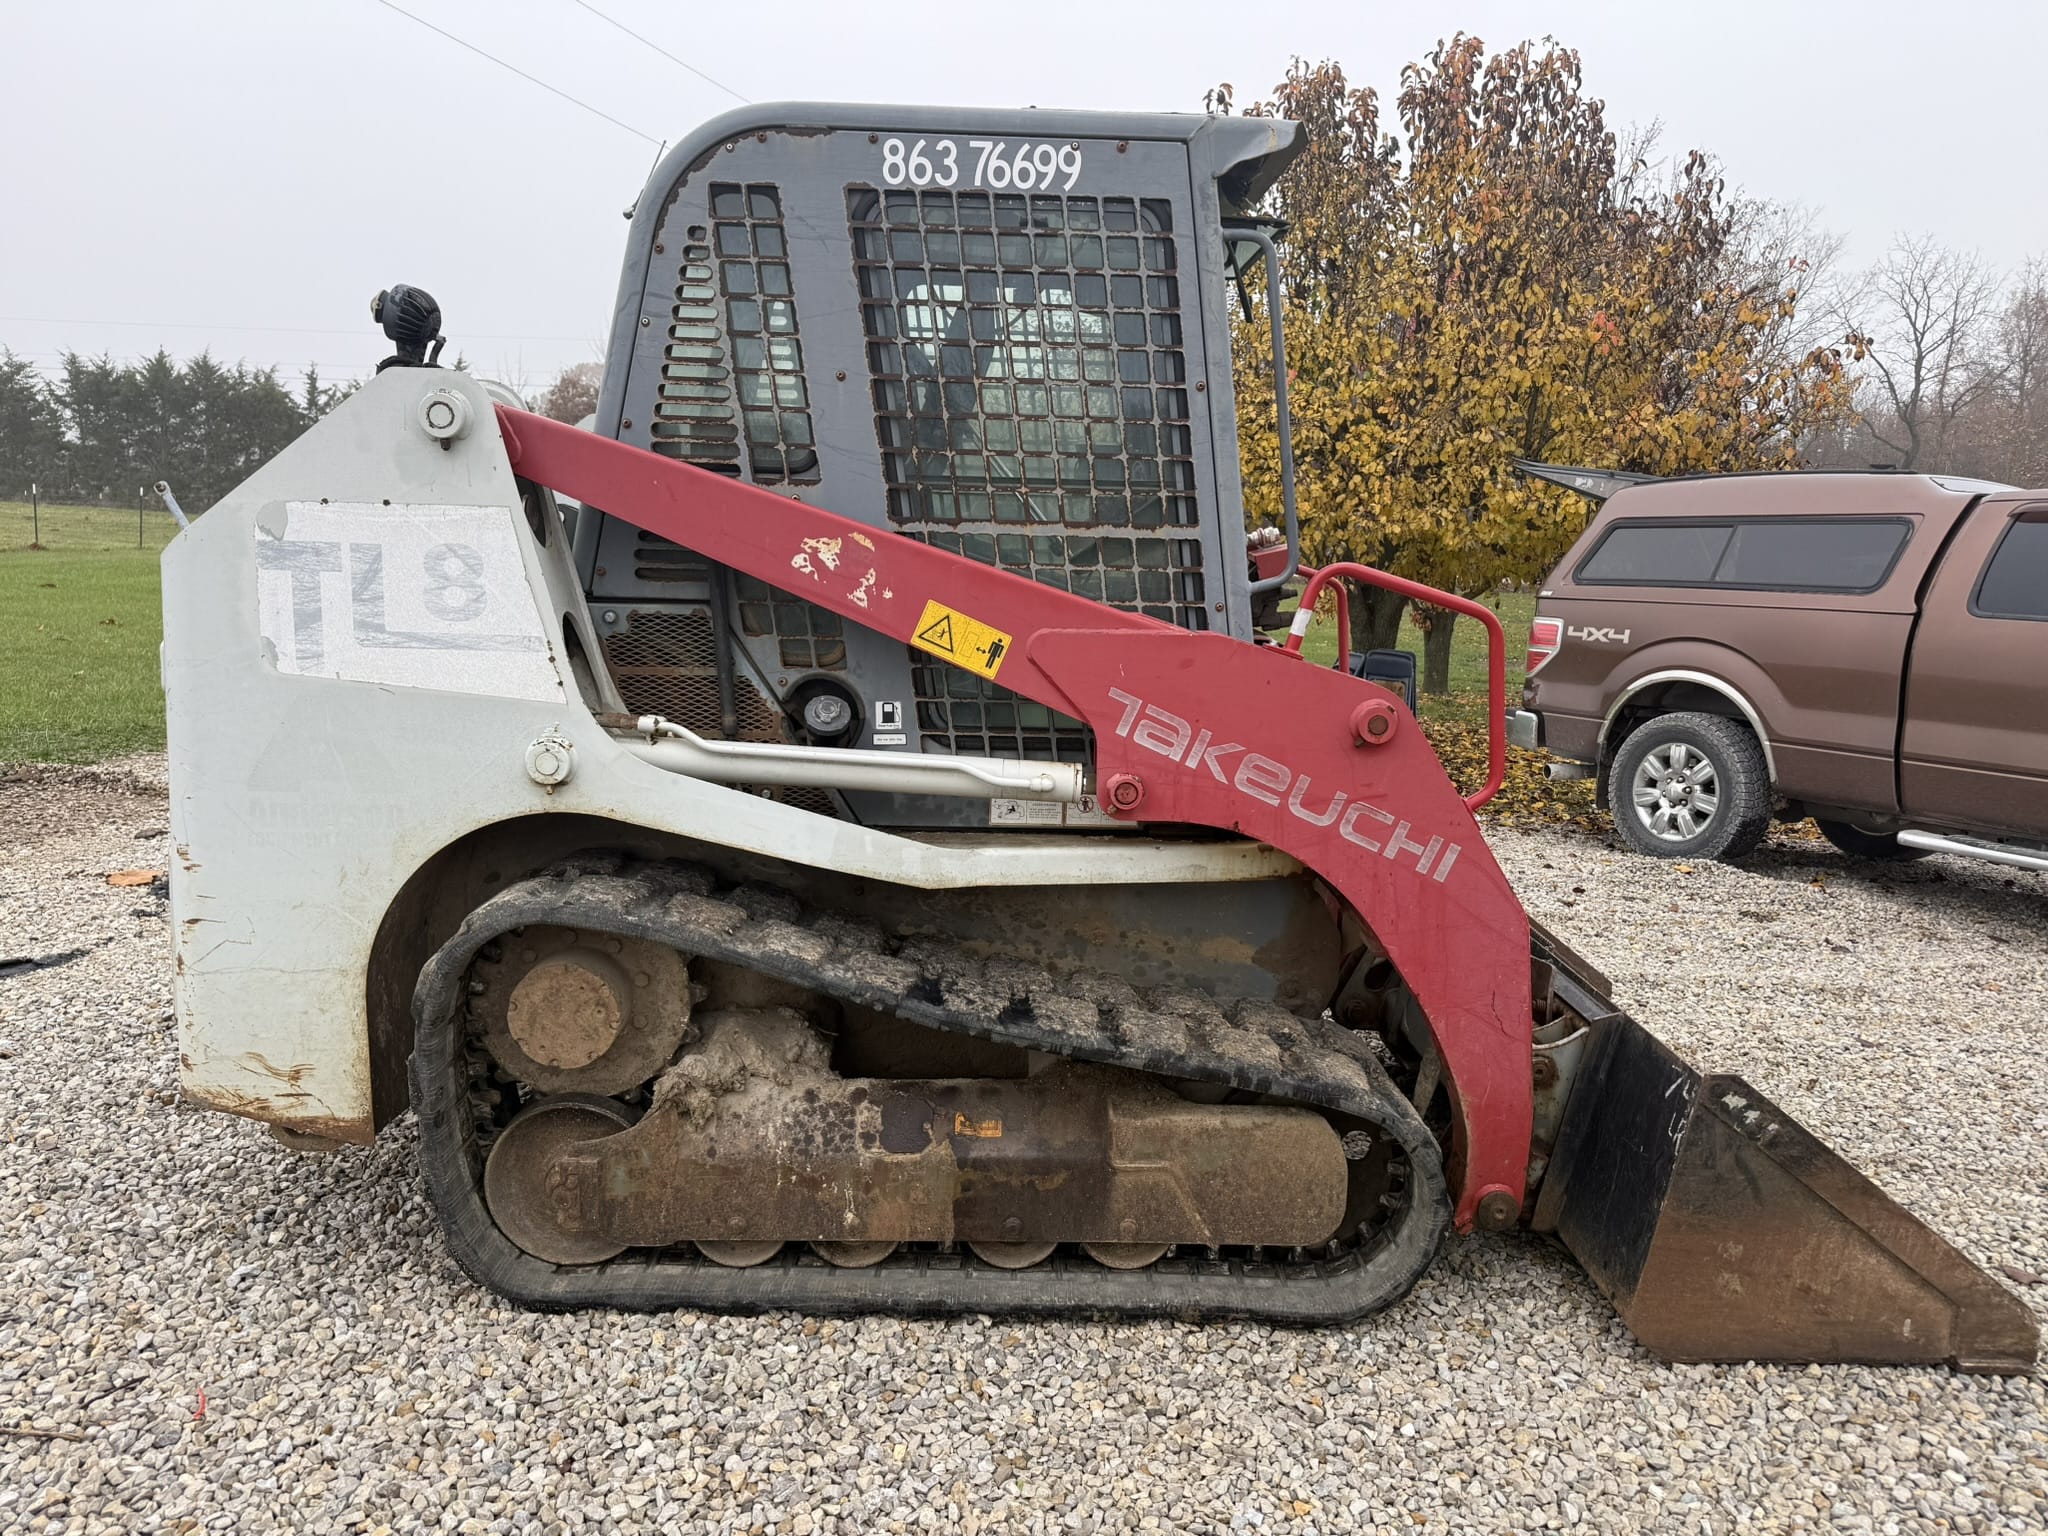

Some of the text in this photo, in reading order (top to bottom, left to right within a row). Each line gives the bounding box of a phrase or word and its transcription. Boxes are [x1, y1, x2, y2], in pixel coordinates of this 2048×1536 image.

[883, 138, 1082, 192] 863 76699
[1567, 625, 1631, 644] 4X4
